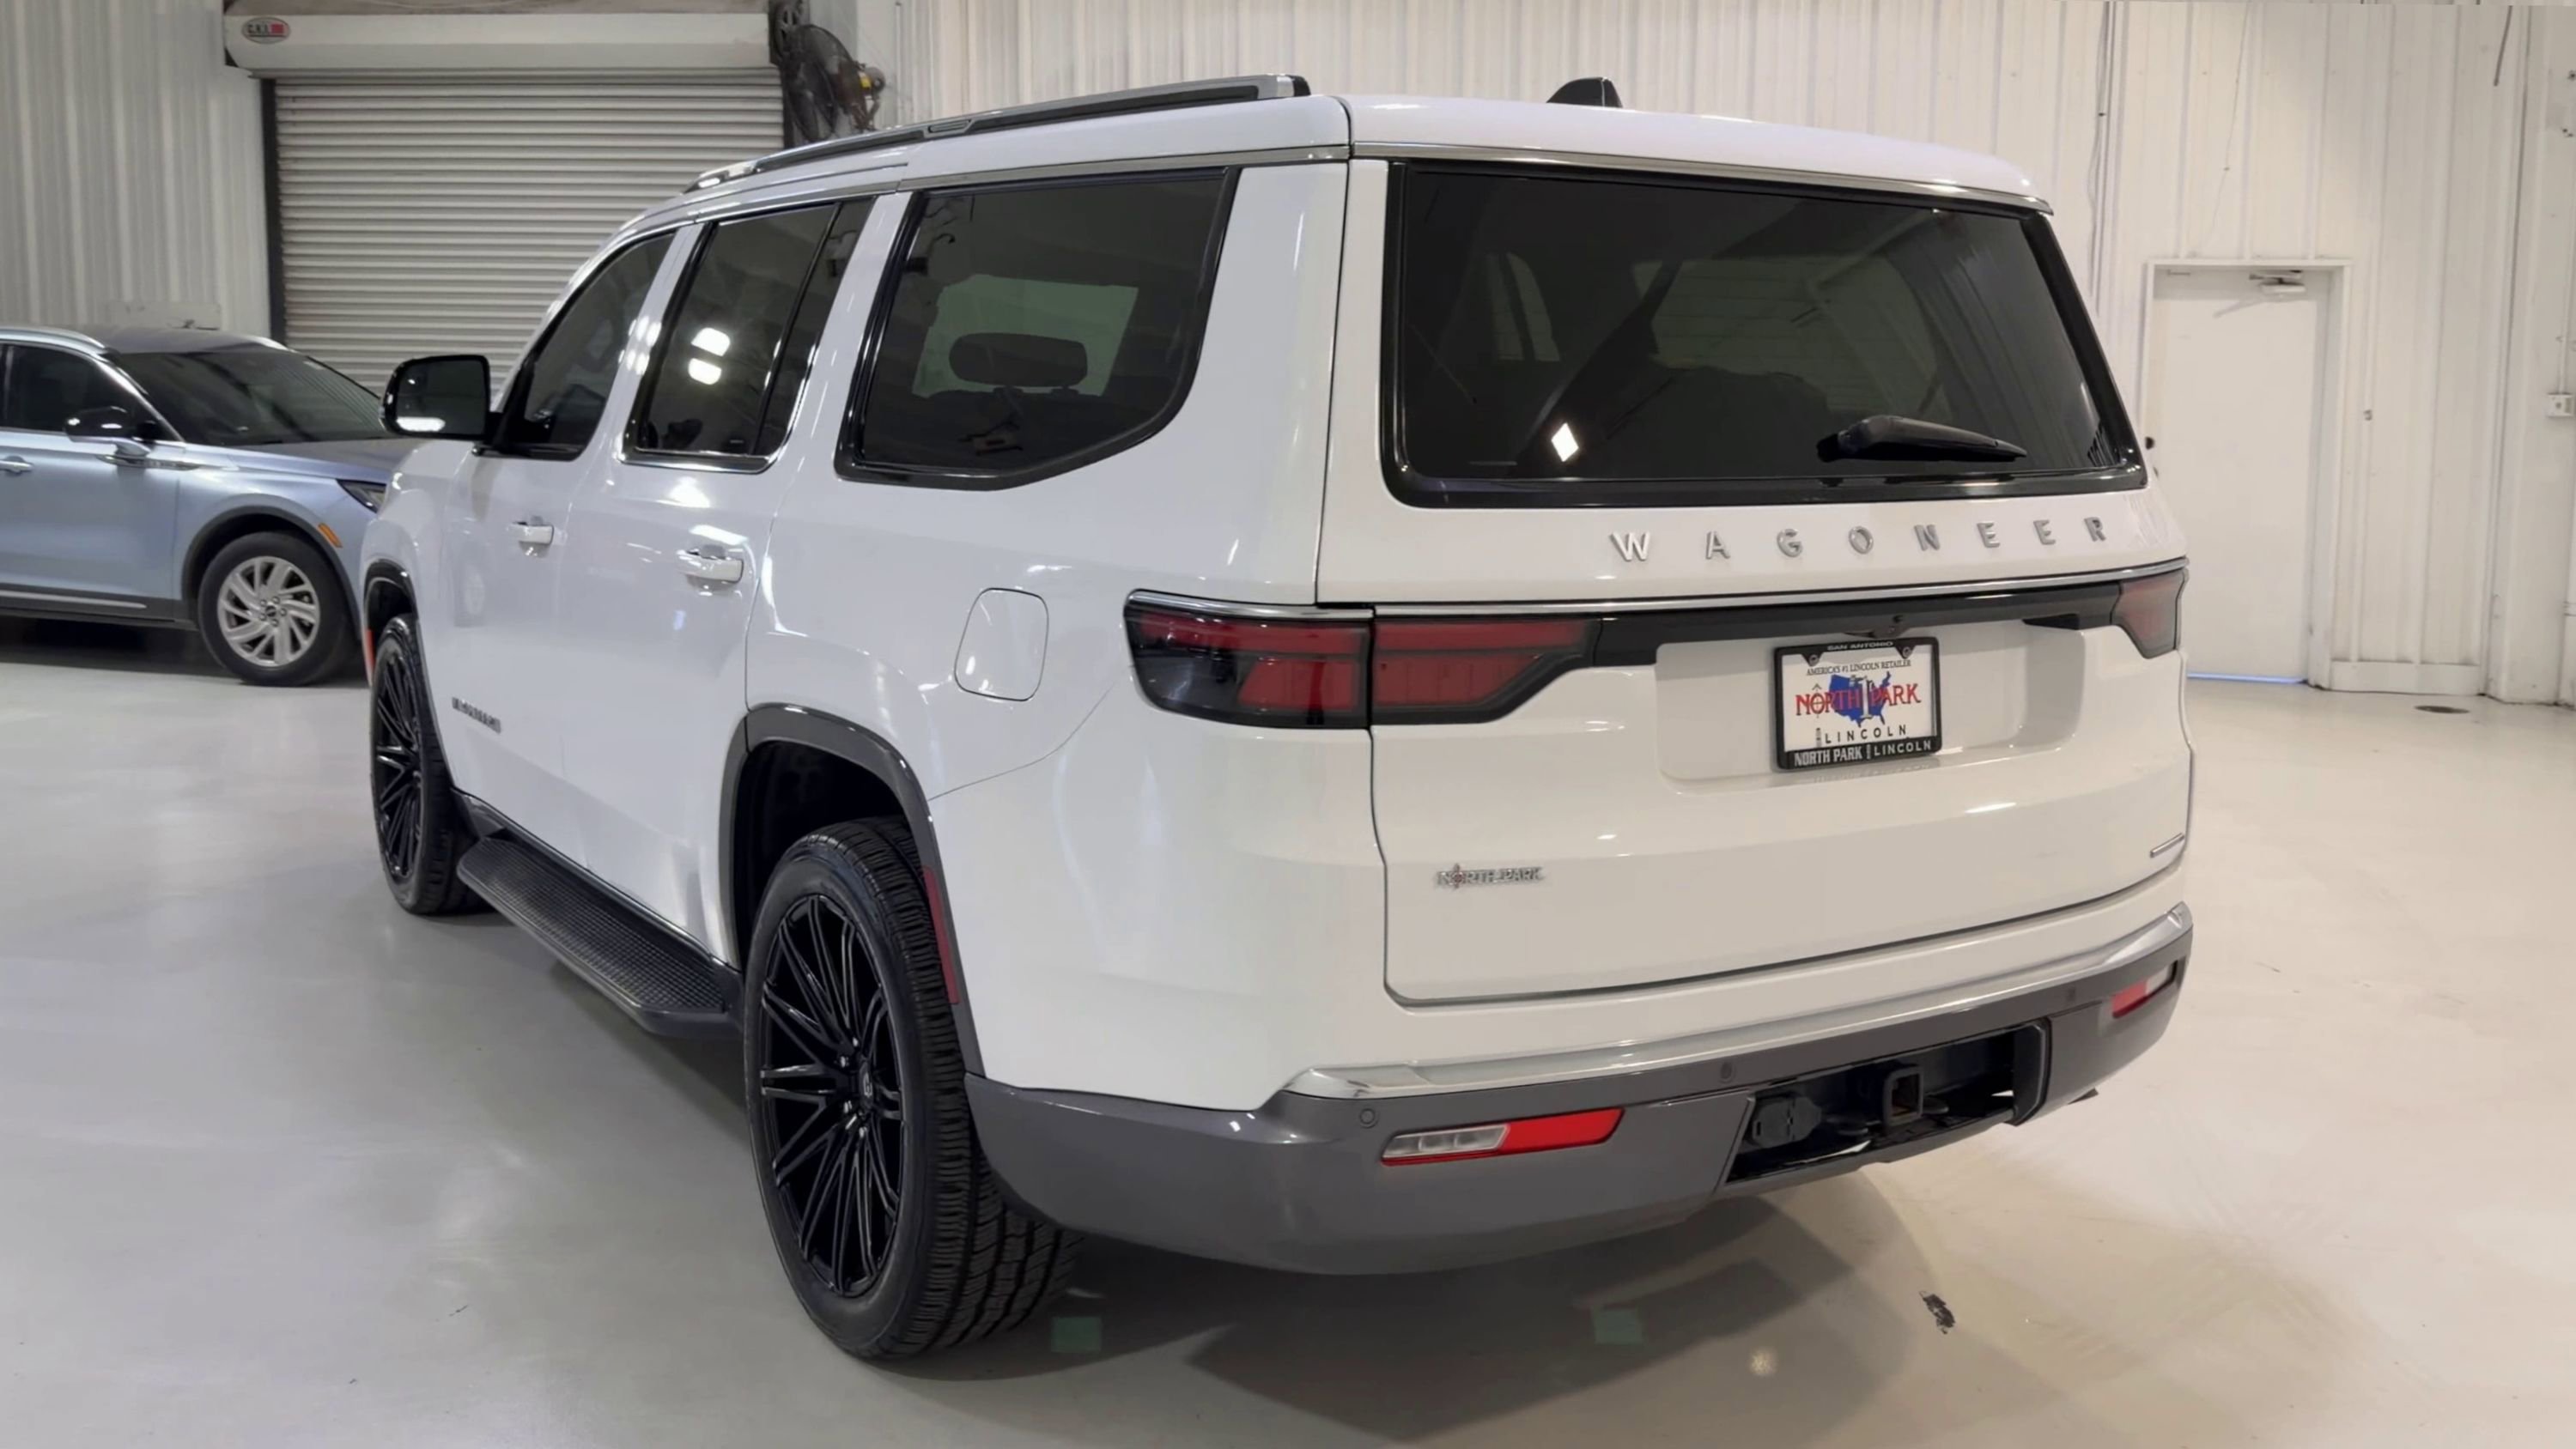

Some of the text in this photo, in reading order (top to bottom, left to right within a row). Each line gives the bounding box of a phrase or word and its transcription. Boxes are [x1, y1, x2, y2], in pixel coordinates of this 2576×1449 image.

[1610, 517, 2107, 561] WAGONEER
[1850, 640, 1894, 649] ANTONIO
[1850, 662, 1880, 672] LINCOLN
[1881, 659, 1911, 670] RETAILER
[1795, 683, 1922, 716] NORTH PARK
[1825, 724, 1906, 744] LINCOLN
[1795, 749, 1831, 767] NORTH
[1832, 745, 1863, 763] PARK
[1874, 740, 1931, 756] LINCOLN
[1437, 866, 1546, 886] NORTH PARK
